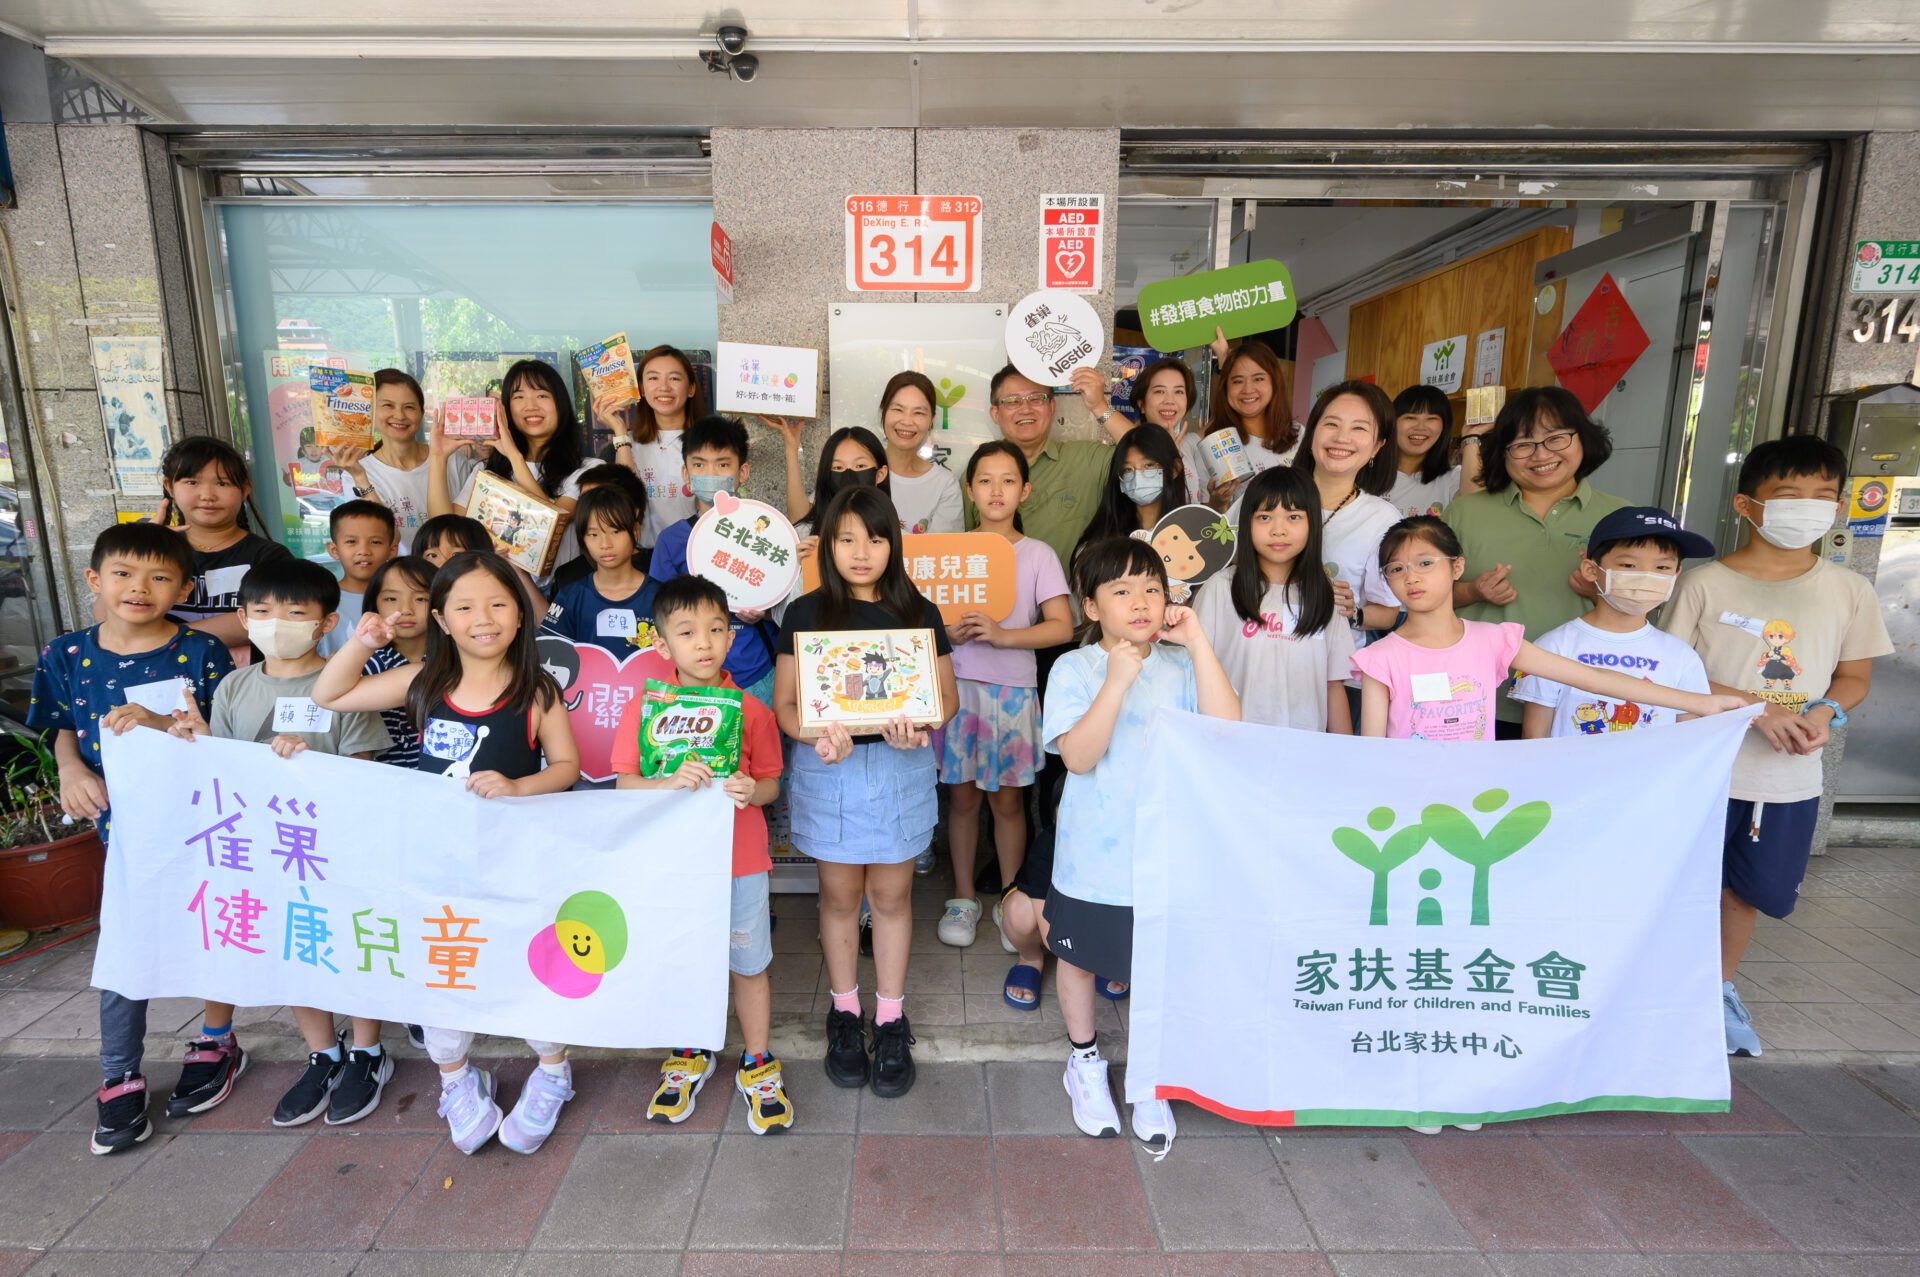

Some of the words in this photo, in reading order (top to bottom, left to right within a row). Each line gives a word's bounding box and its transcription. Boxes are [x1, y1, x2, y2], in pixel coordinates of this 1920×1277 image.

[850, 200, 873, 212] 316
[955, 201, 978, 213] 312
[1046, 197, 1098, 207] 本場所設置
[863, 218, 896, 229] DeXing
[914, 218, 928, 228] R.
[1058, 213, 1085, 223] AED
[1045, 227, 1096, 236] 本場所設置
[869, 234, 959, 276] 314
[1058, 240, 1084, 250] AED
[1877, 264, 1920, 284] 314
[1150, 280, 1287, 327] #發揮食物的力量
[1024, 303, 1051, 328] 雀巢
[1853, 298, 1920, 343] 314
[592, 359, 626, 377] Fitnesse
[326, 395, 372, 412] Fitnesse
[1211, 437, 1238, 453] SUPER
[713, 517, 790, 567] 台北家扶
[711, 549, 766, 587] 感謝您
[1578, 653, 1660, 671] SNOOPY
[656, 715, 714, 735] MILO
[185, 778, 329, 882] 雀巢
[187, 880, 488, 991] 健康兒童
[1294, 948, 1587, 1001] 家扶基金會
[1293, 998, 1343, 1012] Taiwan
[1348, 997, 1383, 1010] Fund
[1387, 996, 1408, 1009] for
[1413, 996, 1475, 1010] Children
[1481, 1000, 1511, 1013] and
[1518, 1001, 1591, 1019] Families
[1351, 1030, 1523, 1059] 台北家扶中心
